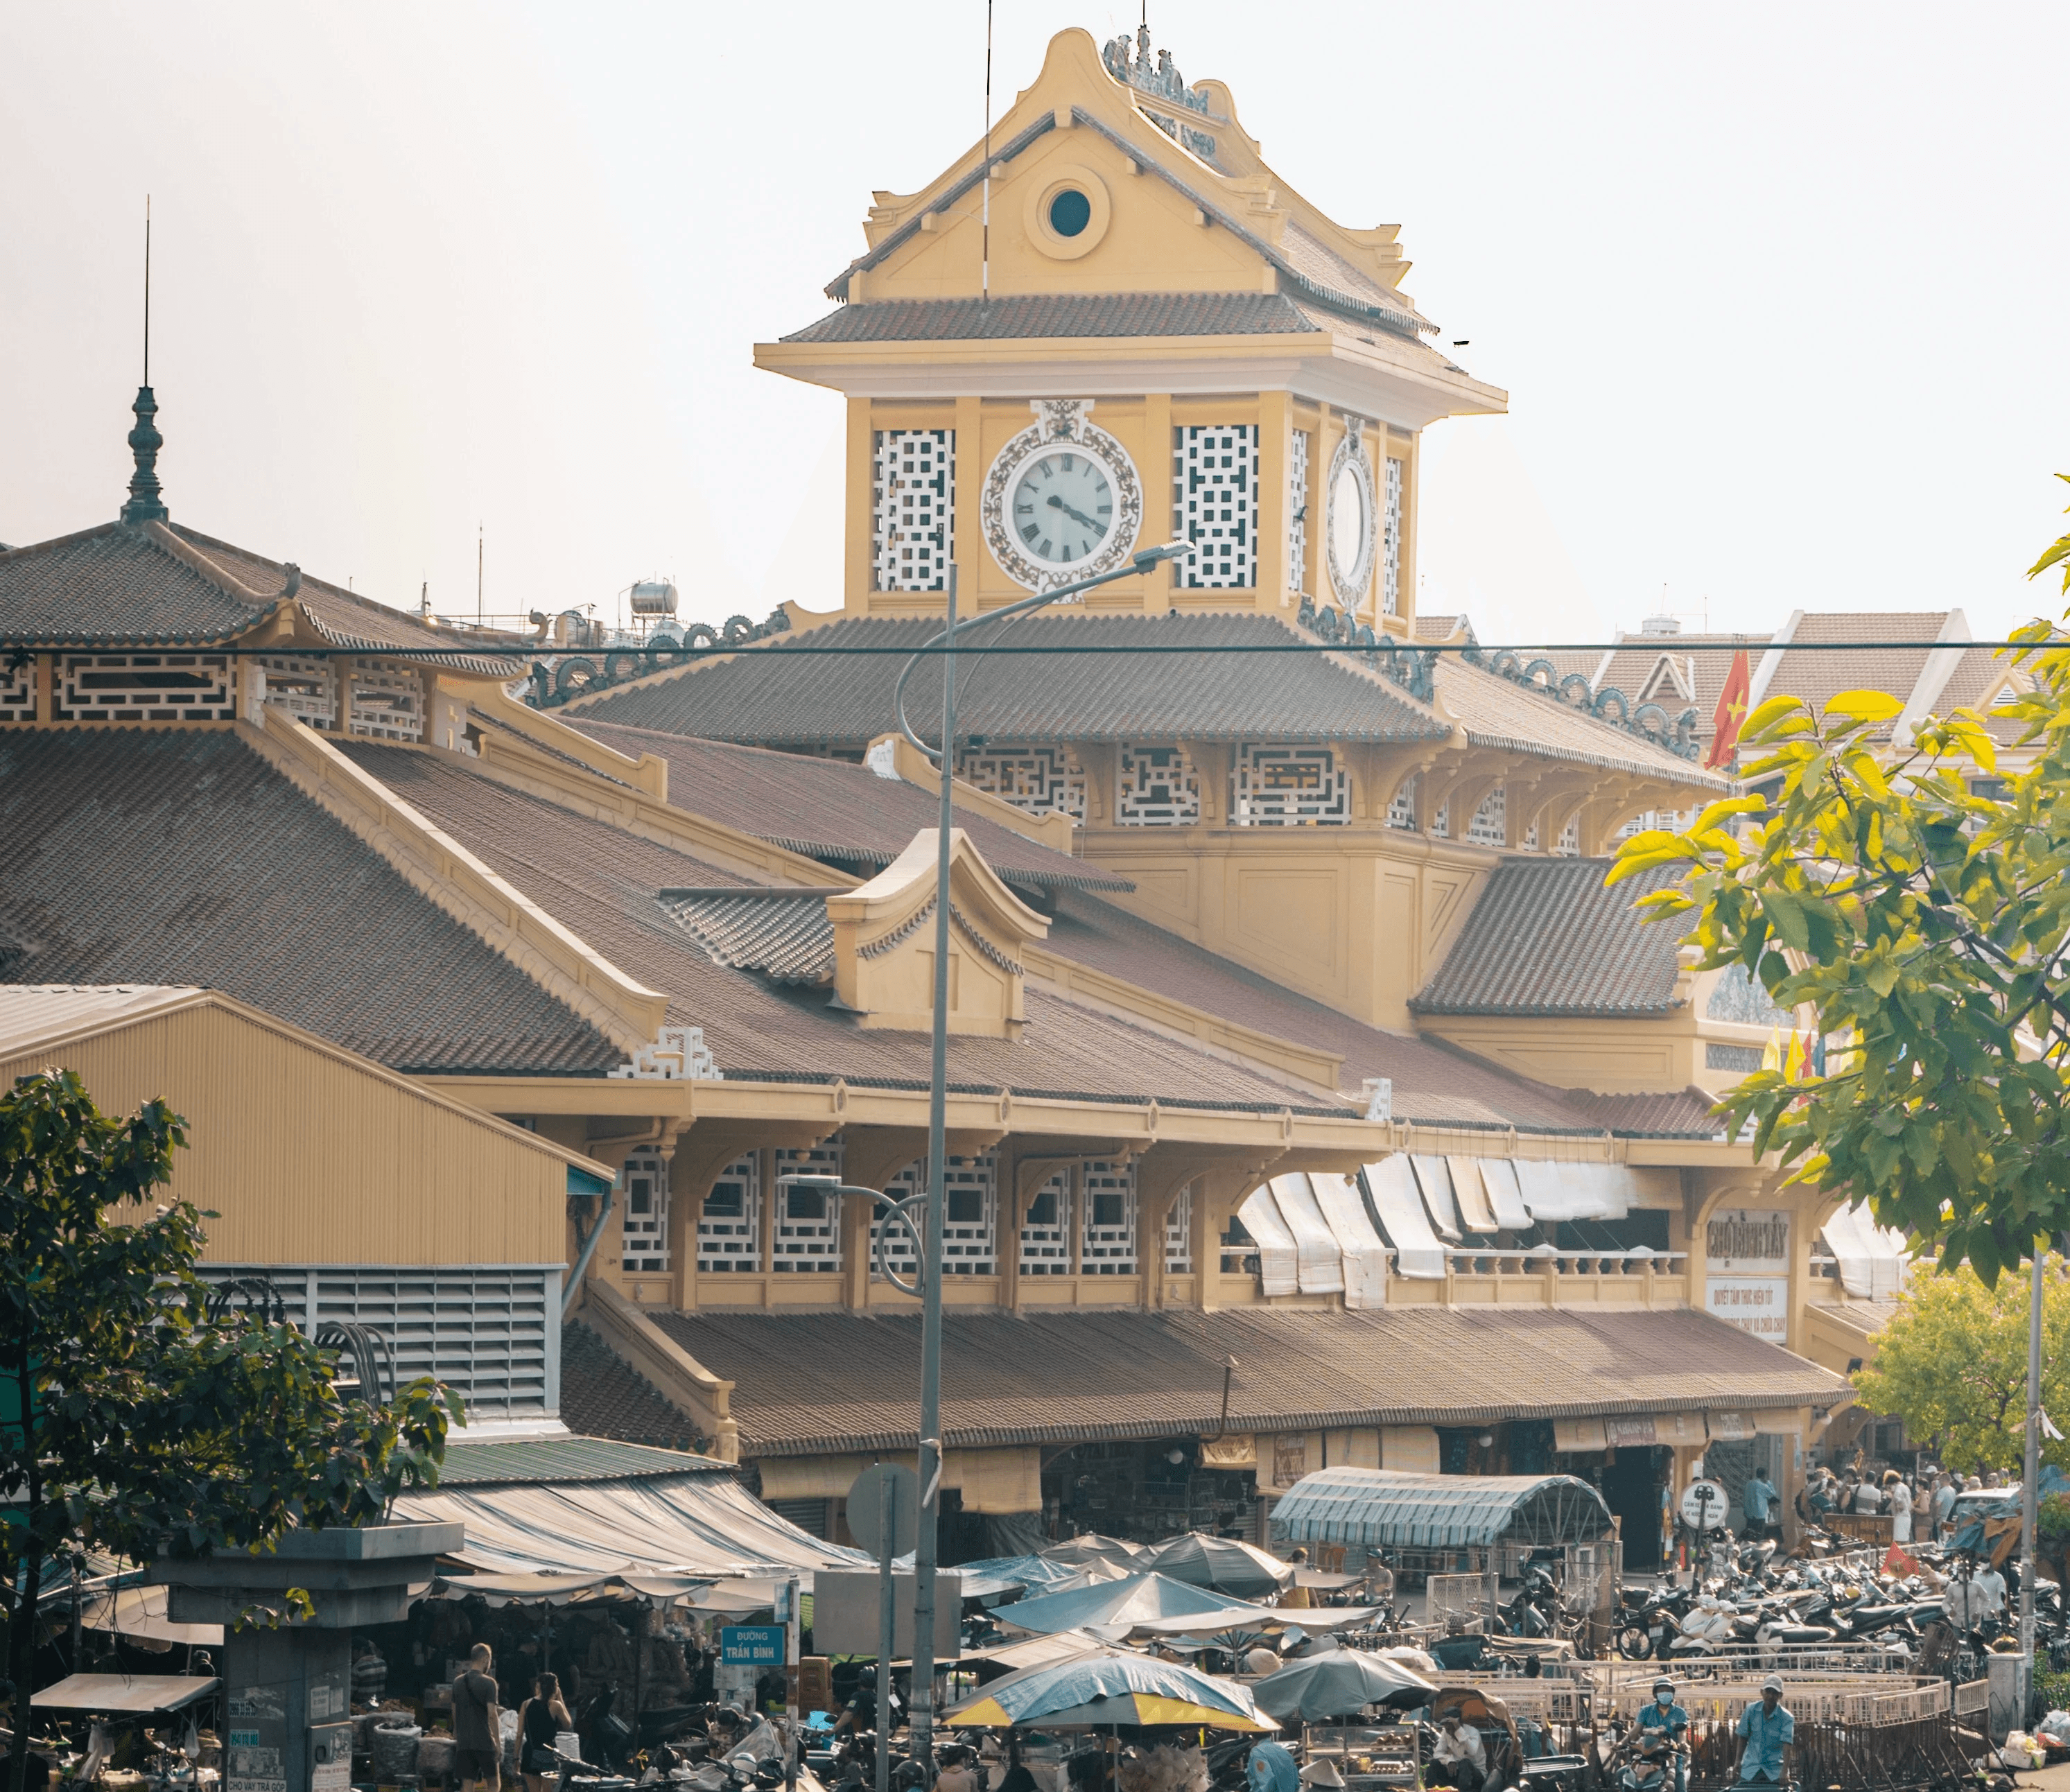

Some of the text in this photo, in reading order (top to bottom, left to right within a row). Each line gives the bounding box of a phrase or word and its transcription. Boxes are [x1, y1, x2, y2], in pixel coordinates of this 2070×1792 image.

[737, 1630, 768, 1641] ĐƯỜNG
[753, 1644, 775, 1659] BÌNH
[228, 1781, 243, 1791] CHO
[243, 1782, 256, 1791] VAY
[271, 1781, 286, 1792] GÓP
